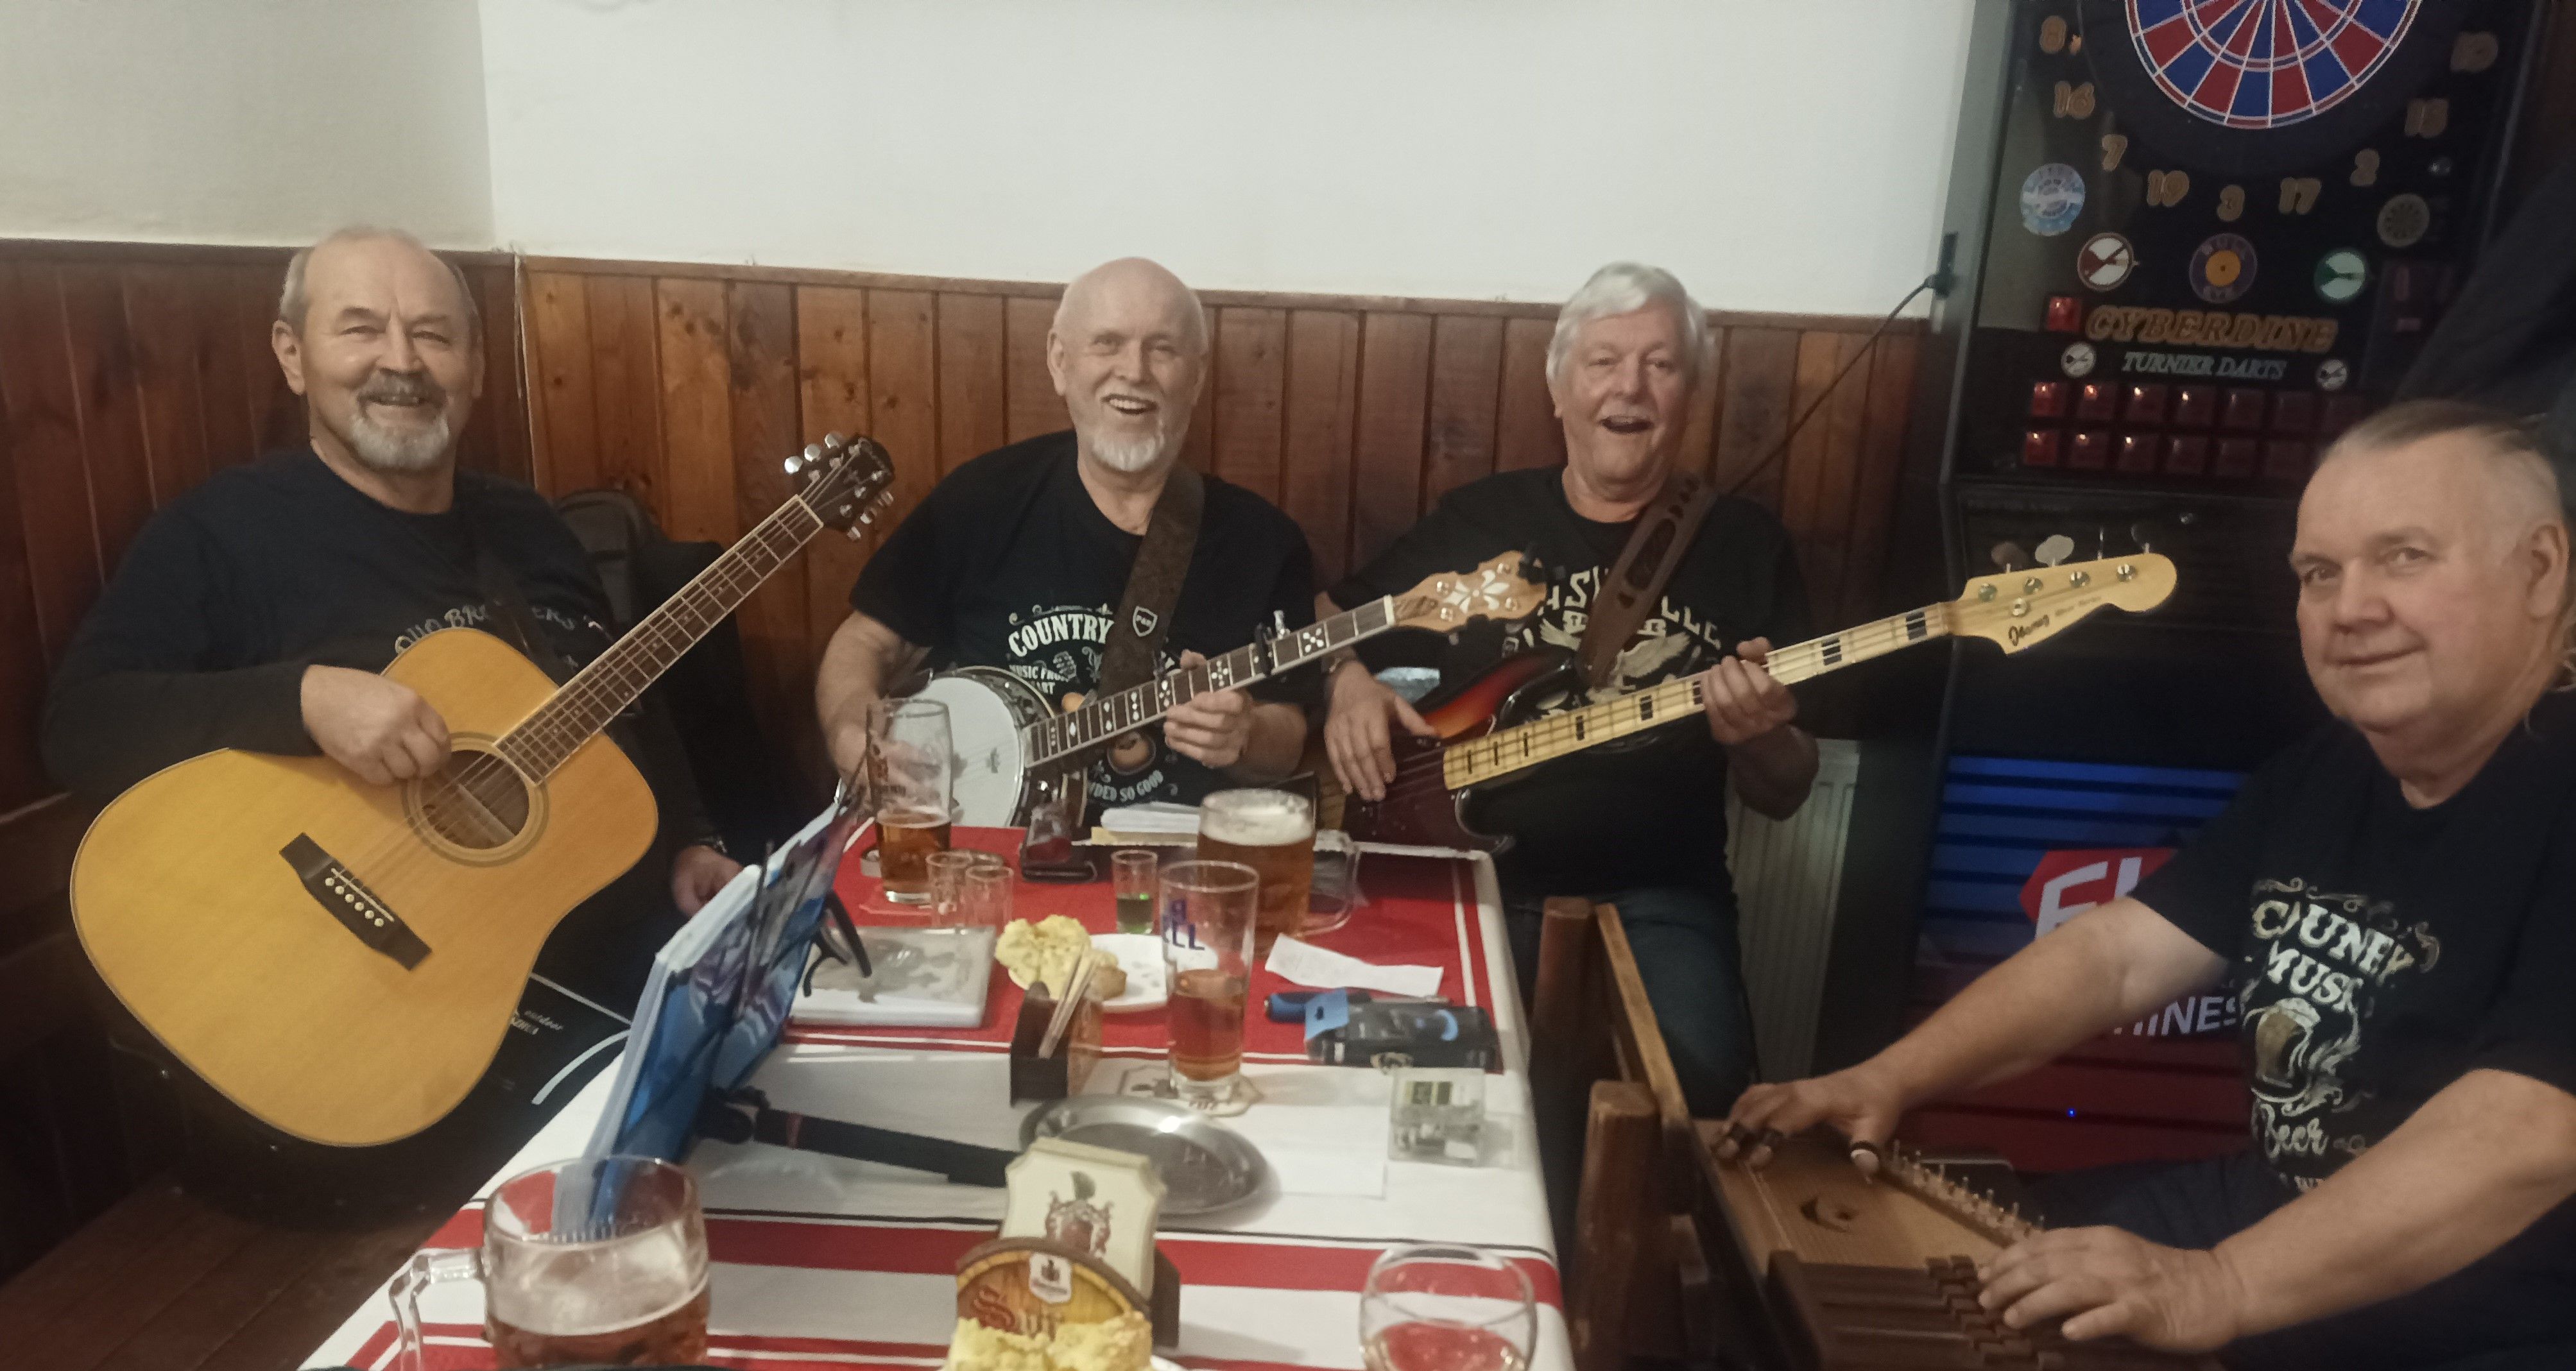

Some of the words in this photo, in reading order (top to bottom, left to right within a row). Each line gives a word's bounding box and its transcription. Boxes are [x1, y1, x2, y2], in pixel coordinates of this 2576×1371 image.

[2054, 80, 2096, 120] 16
[2101, 134, 2128, 172] 7
[2349, 148, 2380, 187] 2
[2216, 184, 2245, 222] 3
[2278, 177, 2323, 216] 17
[2084, 304, 2339, 353] CYBERDINE
[2217, 356, 2288, 380] DARTS
[1008, 614, 1115, 657] COUNTRY
[1120, 786, 1135, 802] SO
